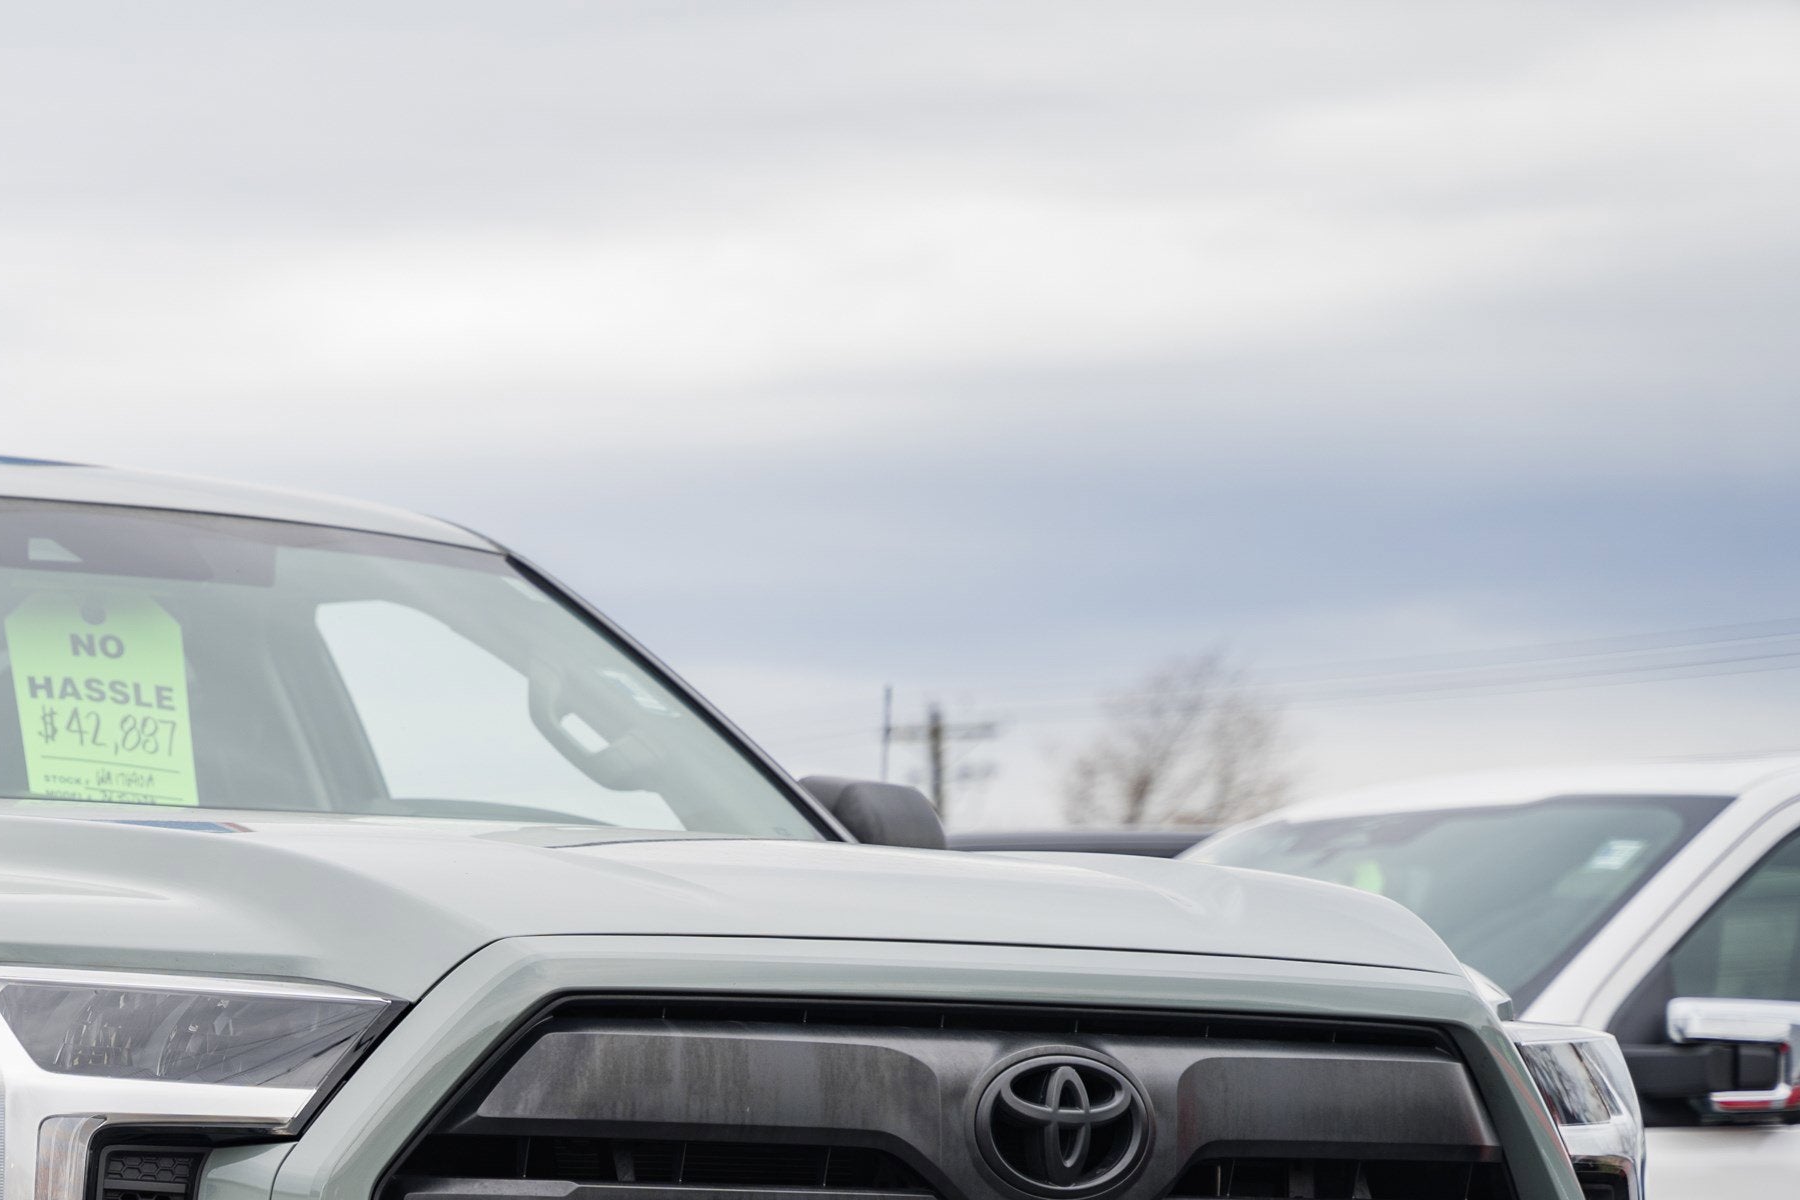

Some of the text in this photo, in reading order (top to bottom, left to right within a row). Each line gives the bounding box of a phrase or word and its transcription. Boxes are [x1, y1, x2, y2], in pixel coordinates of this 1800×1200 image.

[69, 633, 125, 660] NO
[27, 675, 176, 711] HASSLE
[38, 703, 177, 757] $42,887
